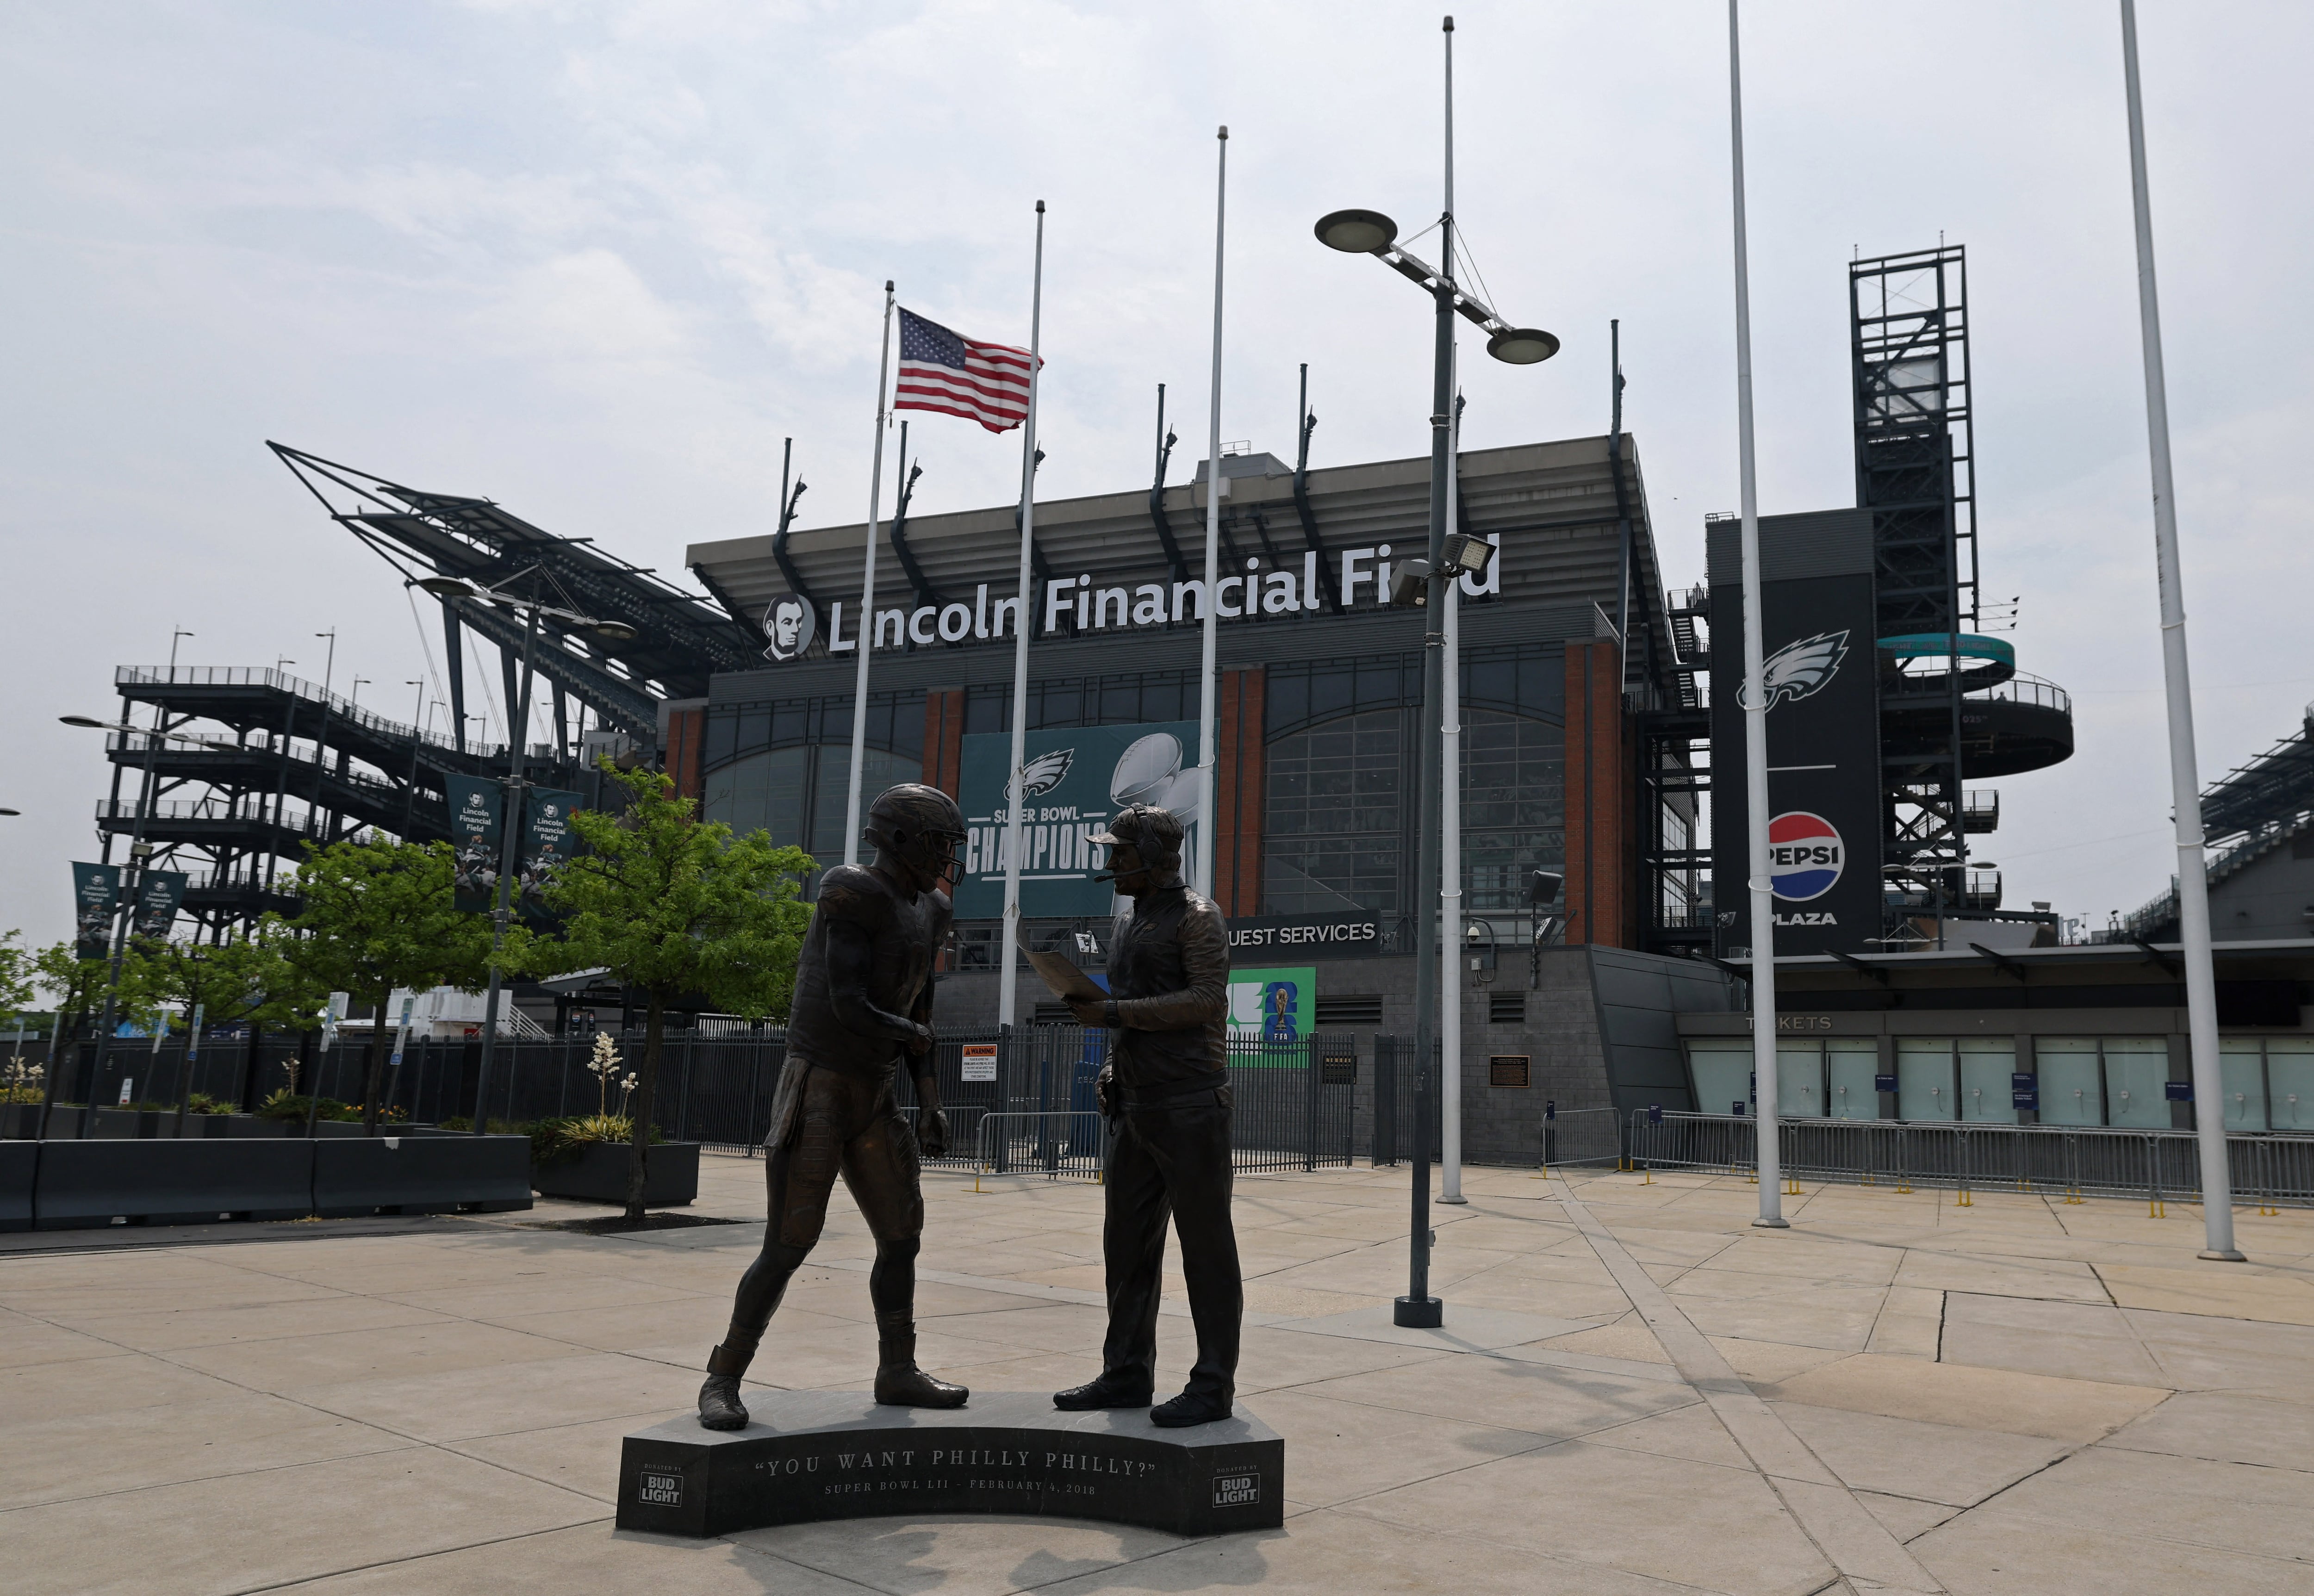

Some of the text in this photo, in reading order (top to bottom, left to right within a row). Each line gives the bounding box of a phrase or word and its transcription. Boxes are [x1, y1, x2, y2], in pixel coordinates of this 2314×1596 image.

[1045, 551, 1320, 632] Financial
[1341, 533, 1500, 606] Fid
[463, 807, 489, 817] Lincoln
[994, 806, 1080, 823] SUER BOWL
[459, 815, 491, 825] Financial
[537, 818, 563, 826] Lincoln
[467, 824, 484, 832] Field
[533, 826, 566, 835] Financial
[1770, 846, 1838, 865] EPSI
[1228, 922, 1376, 947] UEST SERVICES
[1746, 1016, 1832, 1030] TKETS
[755, 1450, 1156, 1478] “YOU WANT PHILLY PHILLY?”
[648, 1476, 675, 1490] BUD
[825, 1483, 871, 1494] SUPER
[880, 1480, 920, 1490] BOWL
[927, 1479, 949, 1489] LII
[970, 1479, 1042, 1490] FEBRUARY
[1049, 1484, 1060, 1493] 4,
[1066, 1484, 1095, 1495] 2018
[1221, 1477, 1251, 1491] BUD
[641, 1488, 679, 1503] LIGHT
[1215, 1488, 1257, 1504] LIGHT
